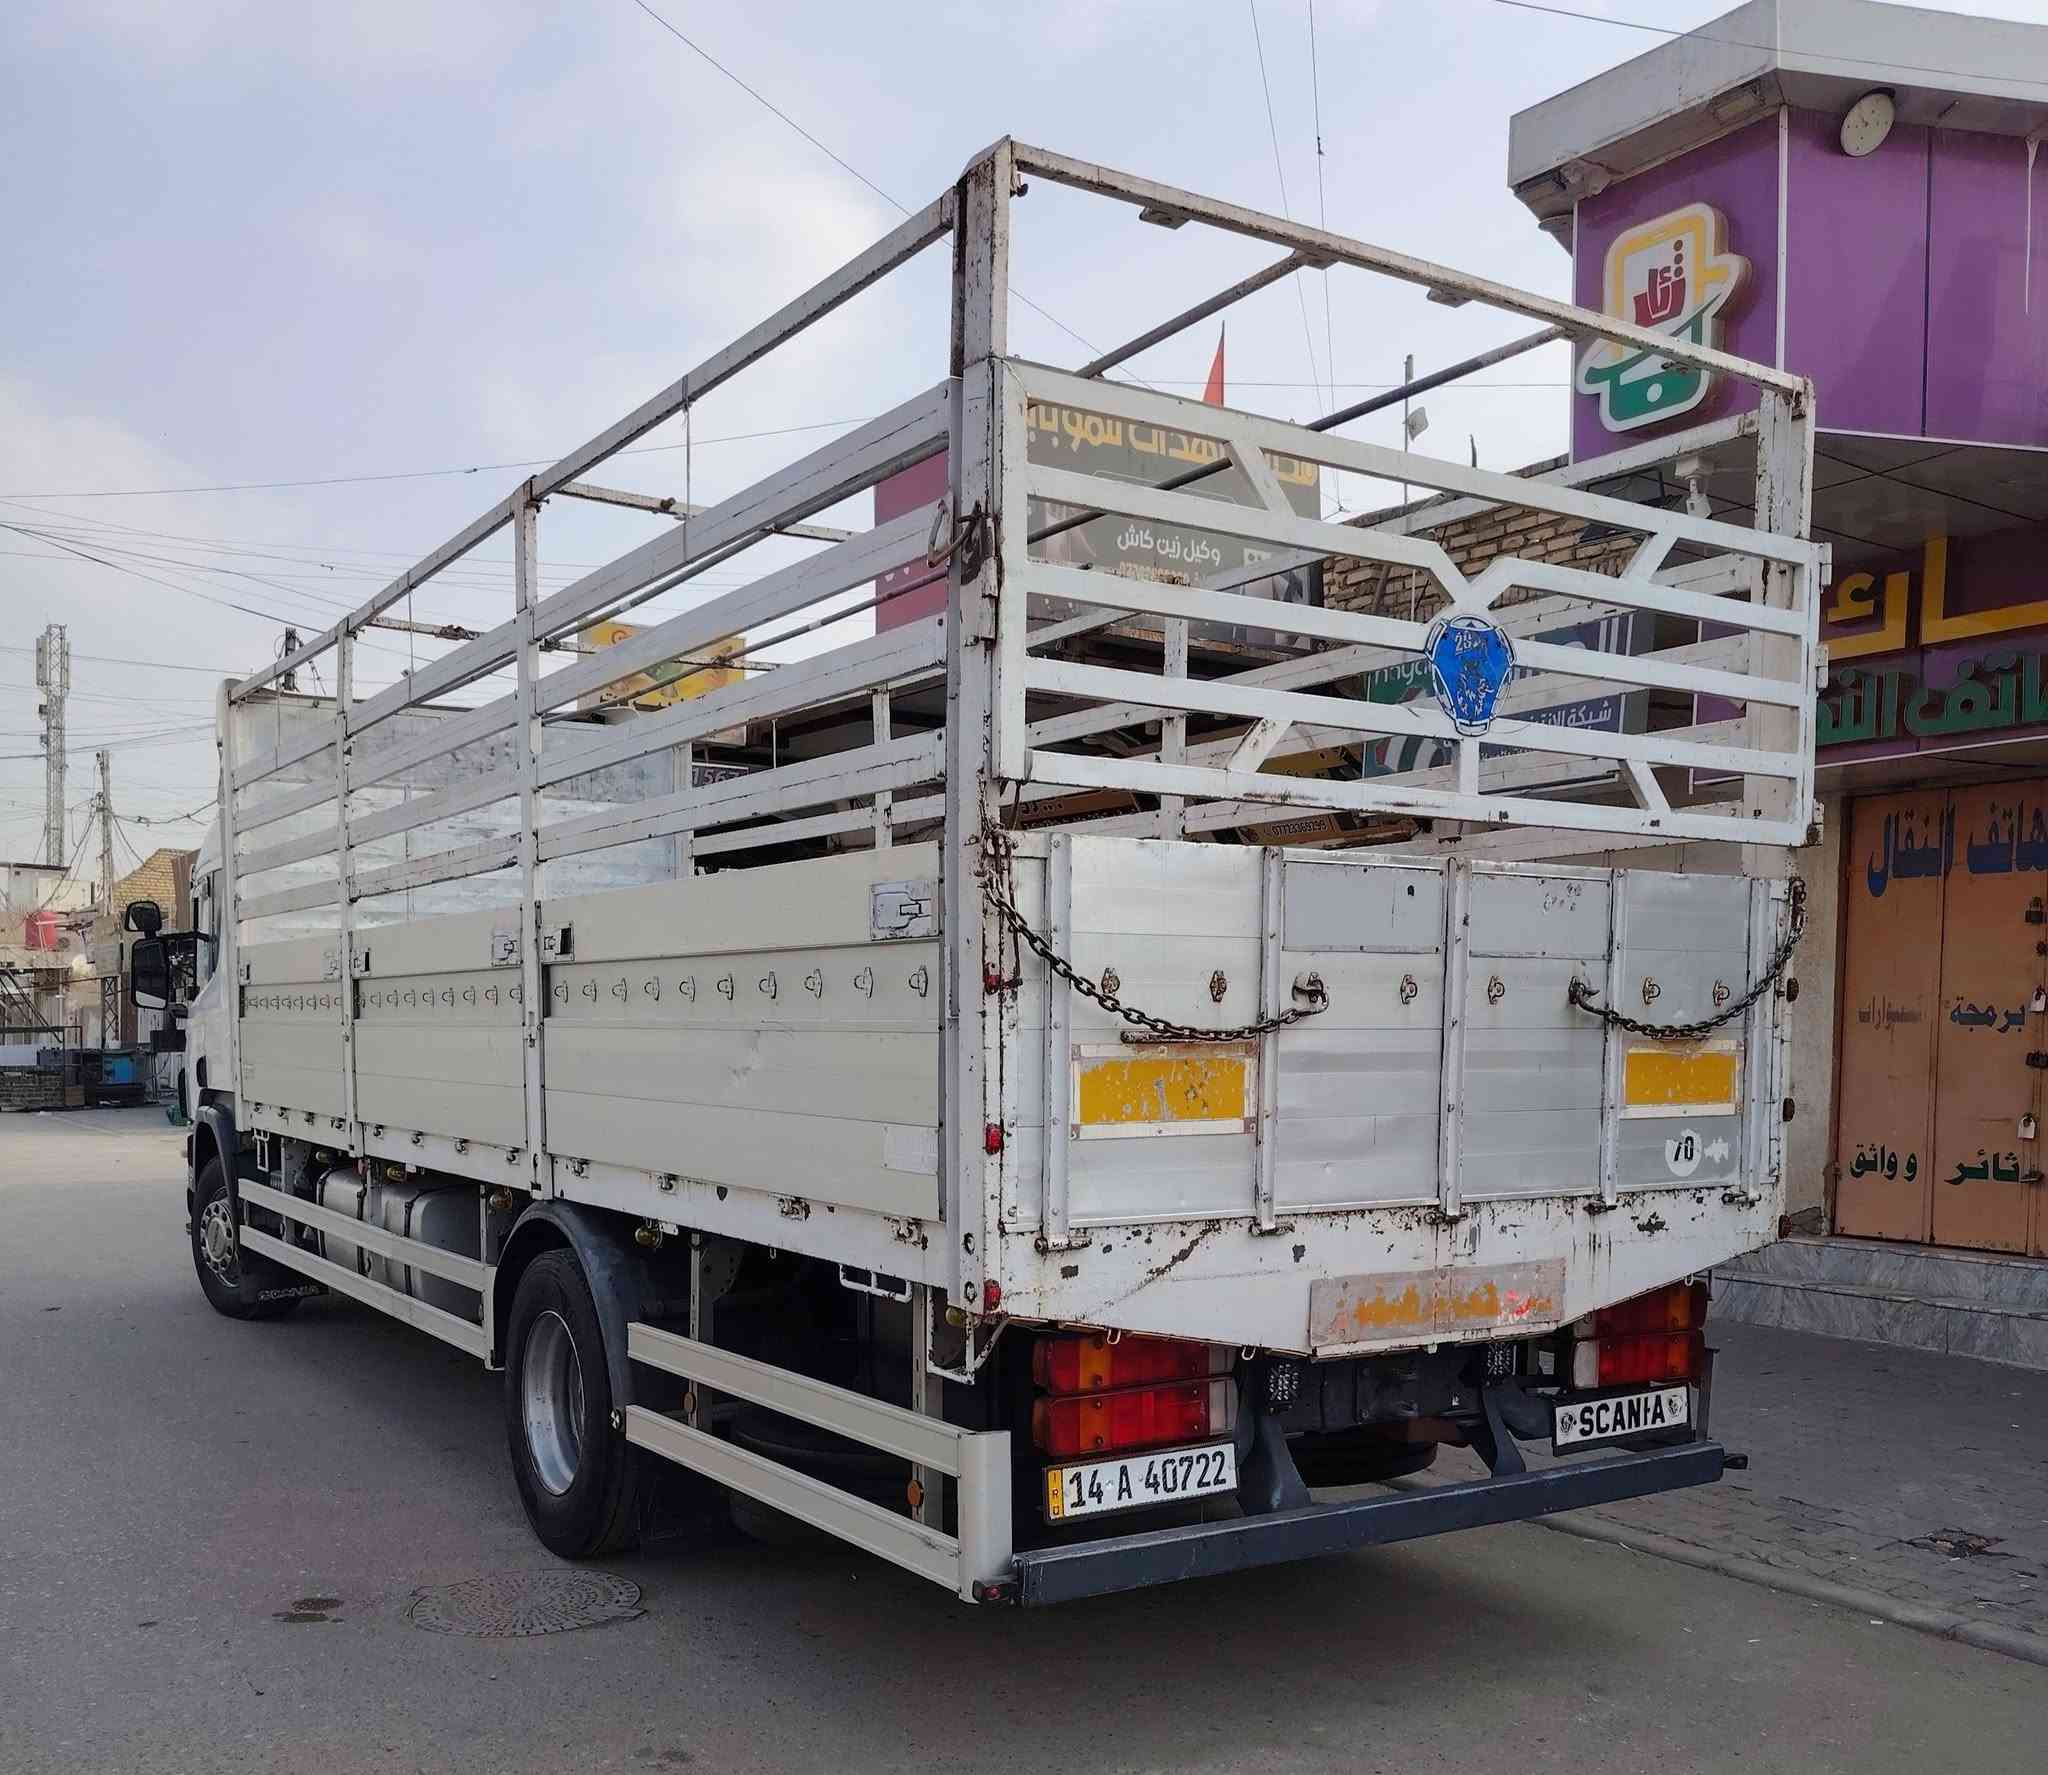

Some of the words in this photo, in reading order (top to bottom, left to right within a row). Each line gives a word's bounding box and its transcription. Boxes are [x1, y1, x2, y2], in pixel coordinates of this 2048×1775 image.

[1117, 524, 1155, 550] كاش
[1156, 535, 1181, 560] زين
[1183, 539, 1221, 566] وكيل
[1867, 801, 1955, 897] النقال
[1951, 996, 2025, 1033] برمجة
[1944, 1148, 2020, 1185] ثائر
[1579, 1394, 1666, 1437] SCANIA
[1069, 1468, 1104, 1508] 14
[1117, 1464, 1133, 1501] A
[1144, 1450, 1227, 1495] 40722
